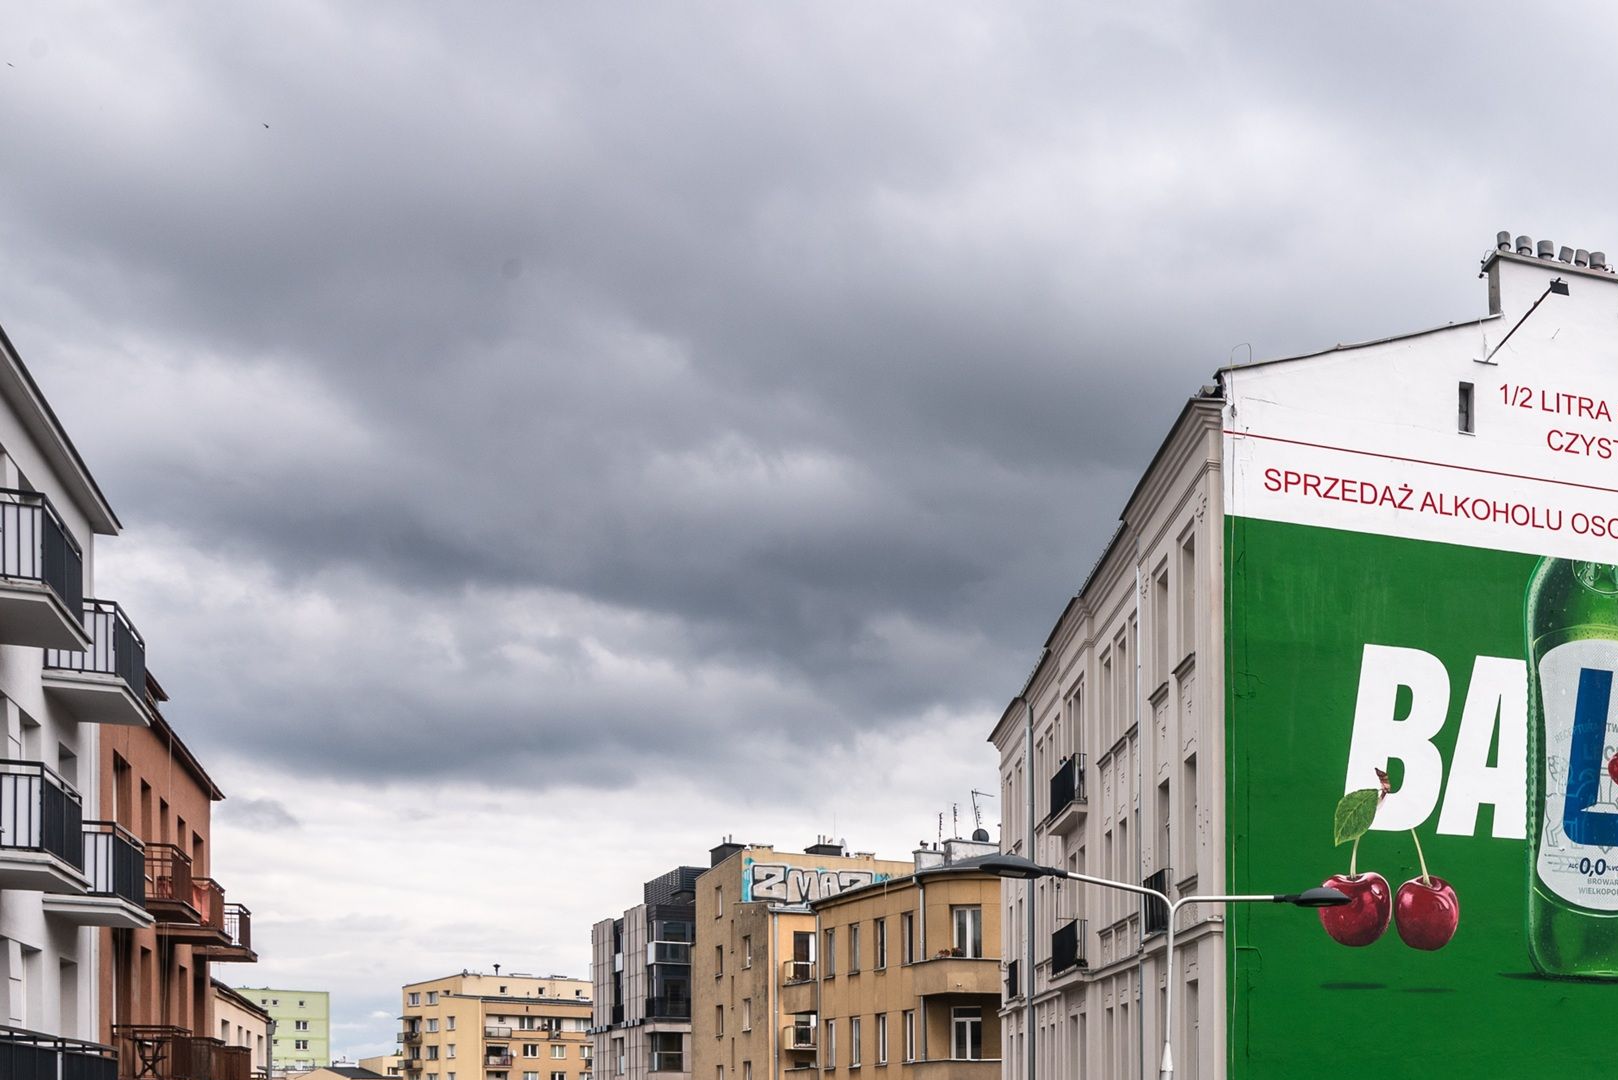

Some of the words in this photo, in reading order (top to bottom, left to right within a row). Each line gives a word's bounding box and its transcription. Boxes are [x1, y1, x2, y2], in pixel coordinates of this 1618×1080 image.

[1500, 384, 1533, 408] 1/2
[1541, 391, 1612, 420] LITRA
[1264, 467, 1414, 511] SPRZEDAŻ
[1419, 491, 1563, 532] ALKOHOLU
